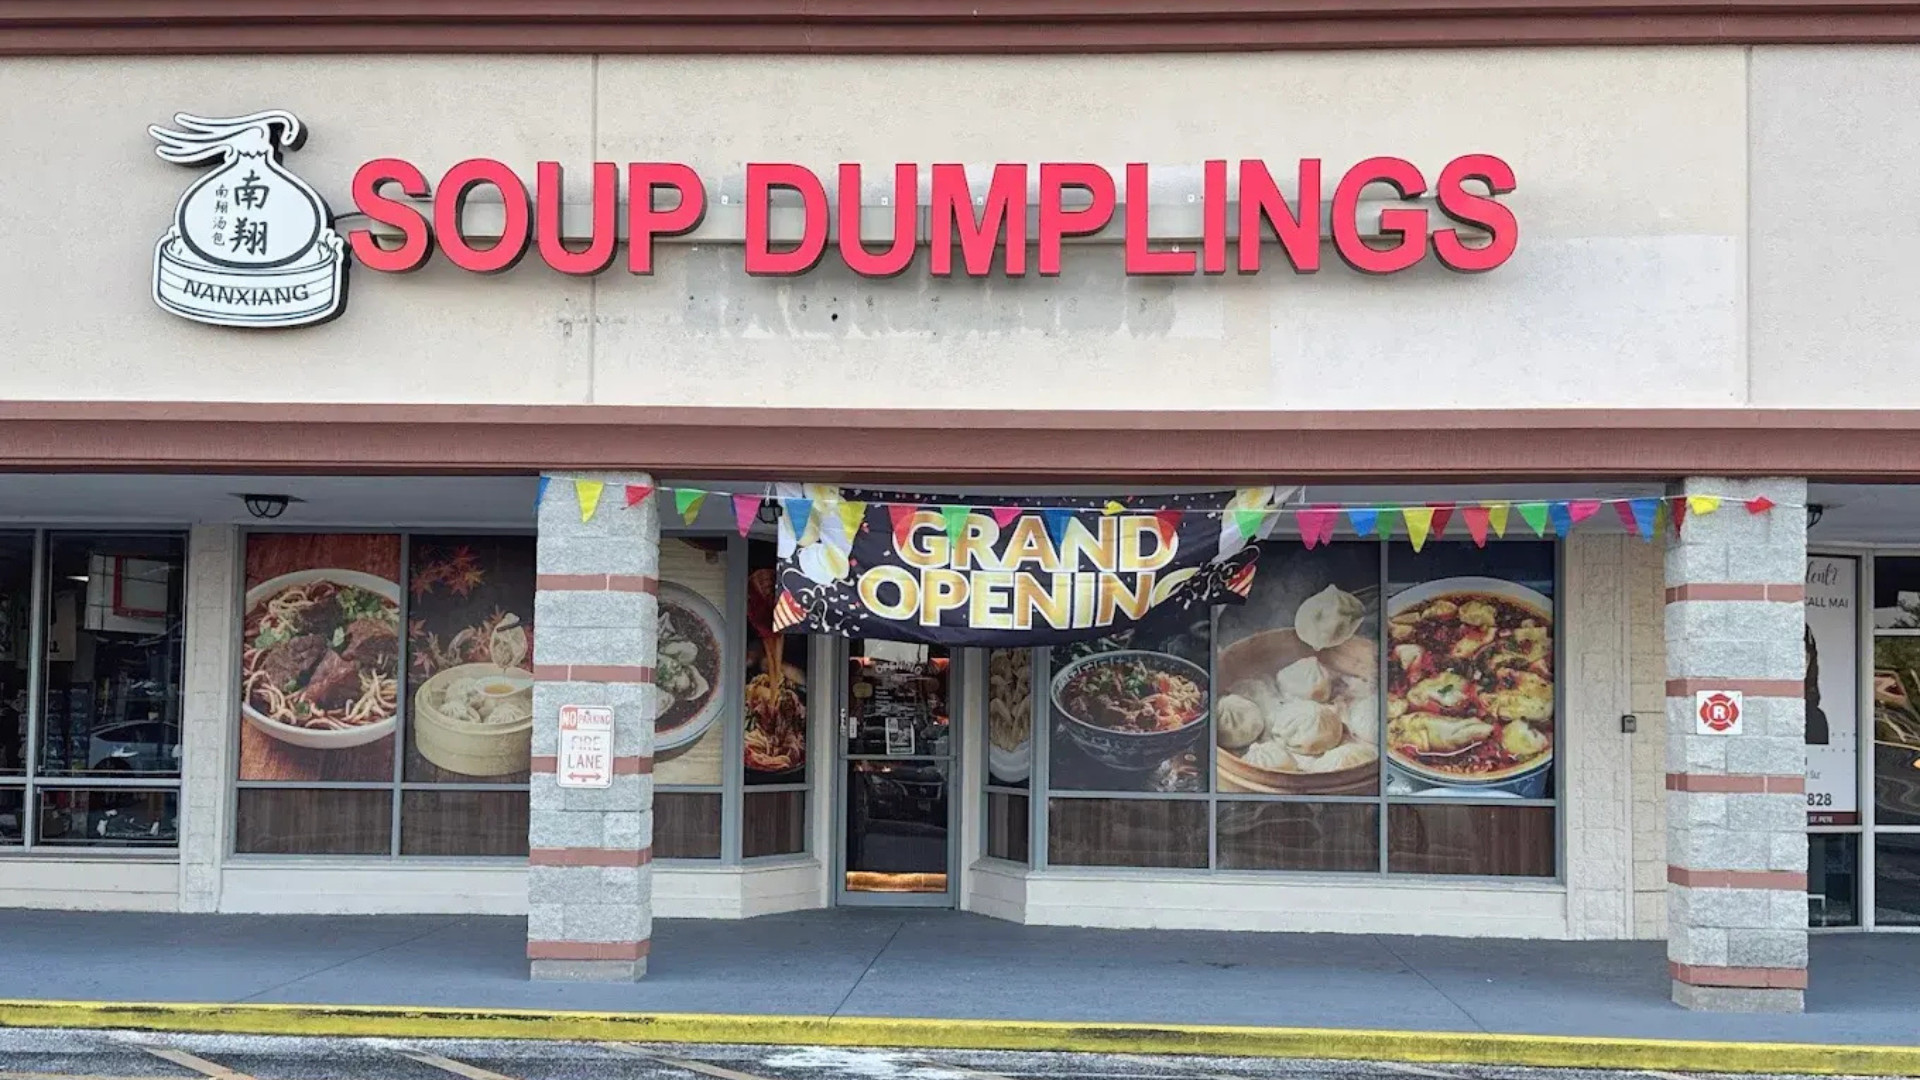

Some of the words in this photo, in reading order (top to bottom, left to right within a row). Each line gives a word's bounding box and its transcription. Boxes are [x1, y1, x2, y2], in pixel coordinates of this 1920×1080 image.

[229, 169, 269, 255] 南翔
[349, 157, 707, 275] SOUP
[745, 154, 1519, 276] DUMPLINGS
[183, 279, 309, 306] NANXIANG
[891, 510, 1180, 572] GRAND
[562, 711, 576, 727] NO
[578, 714, 611, 725] PARKING
[1713, 706, 1726, 719] R
[571, 736, 601, 751] FIRE
[568, 754, 603, 769] LANE
[1806, 792, 1832, 806] 828
